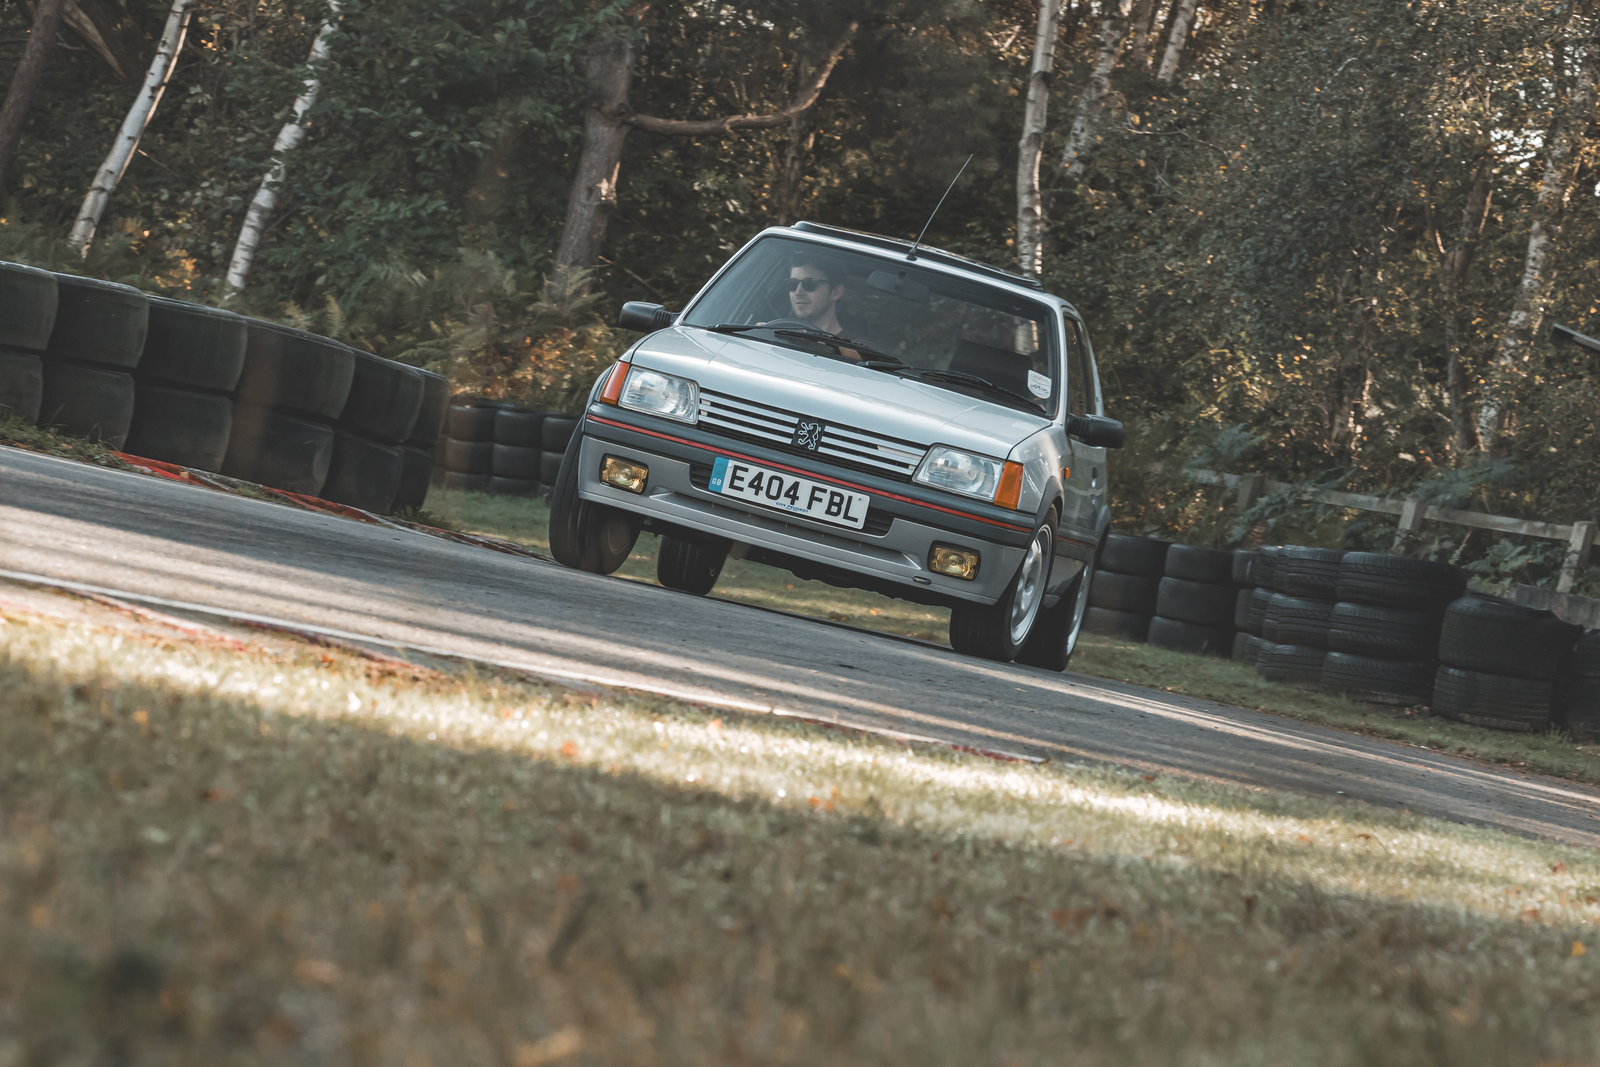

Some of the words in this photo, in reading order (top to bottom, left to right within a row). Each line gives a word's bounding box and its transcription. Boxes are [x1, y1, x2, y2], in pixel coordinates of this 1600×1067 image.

[711, 477, 722, 486] GB
[728, 464, 801, 506] E404
[806, 485, 859, 523] FBL
